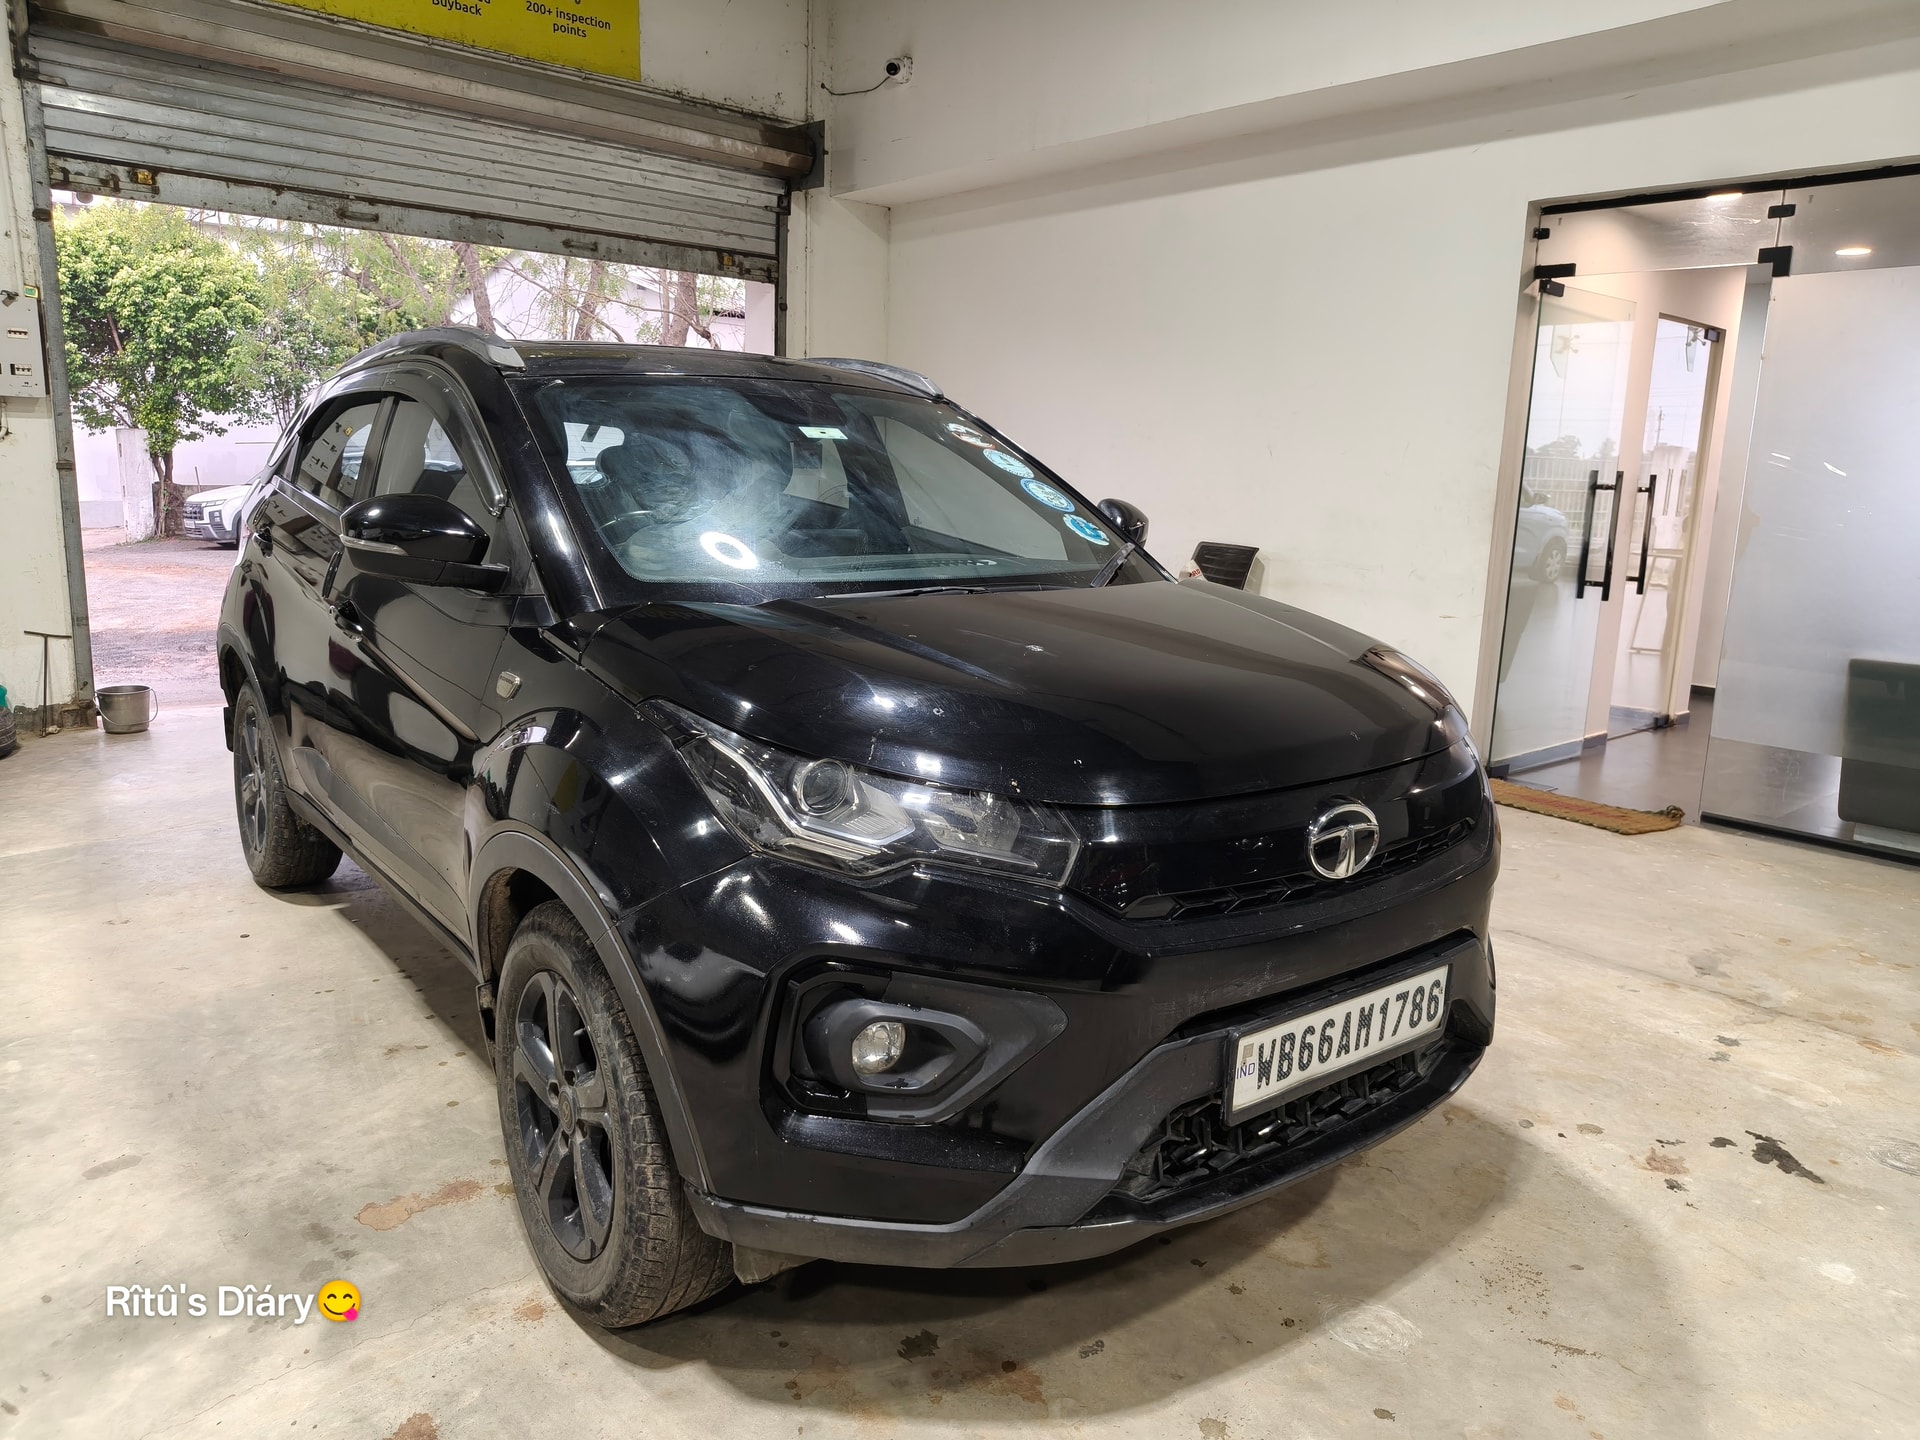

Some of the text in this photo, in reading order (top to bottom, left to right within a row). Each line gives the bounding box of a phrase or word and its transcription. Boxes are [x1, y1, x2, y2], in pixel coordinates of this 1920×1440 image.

[526, 0, 611, 30] 200+ inspection
[553, 22, 587, 38] points
[1256, 979, 1442, 1090] WB66AM1786
[1236, 1062, 1256, 1080] IND
